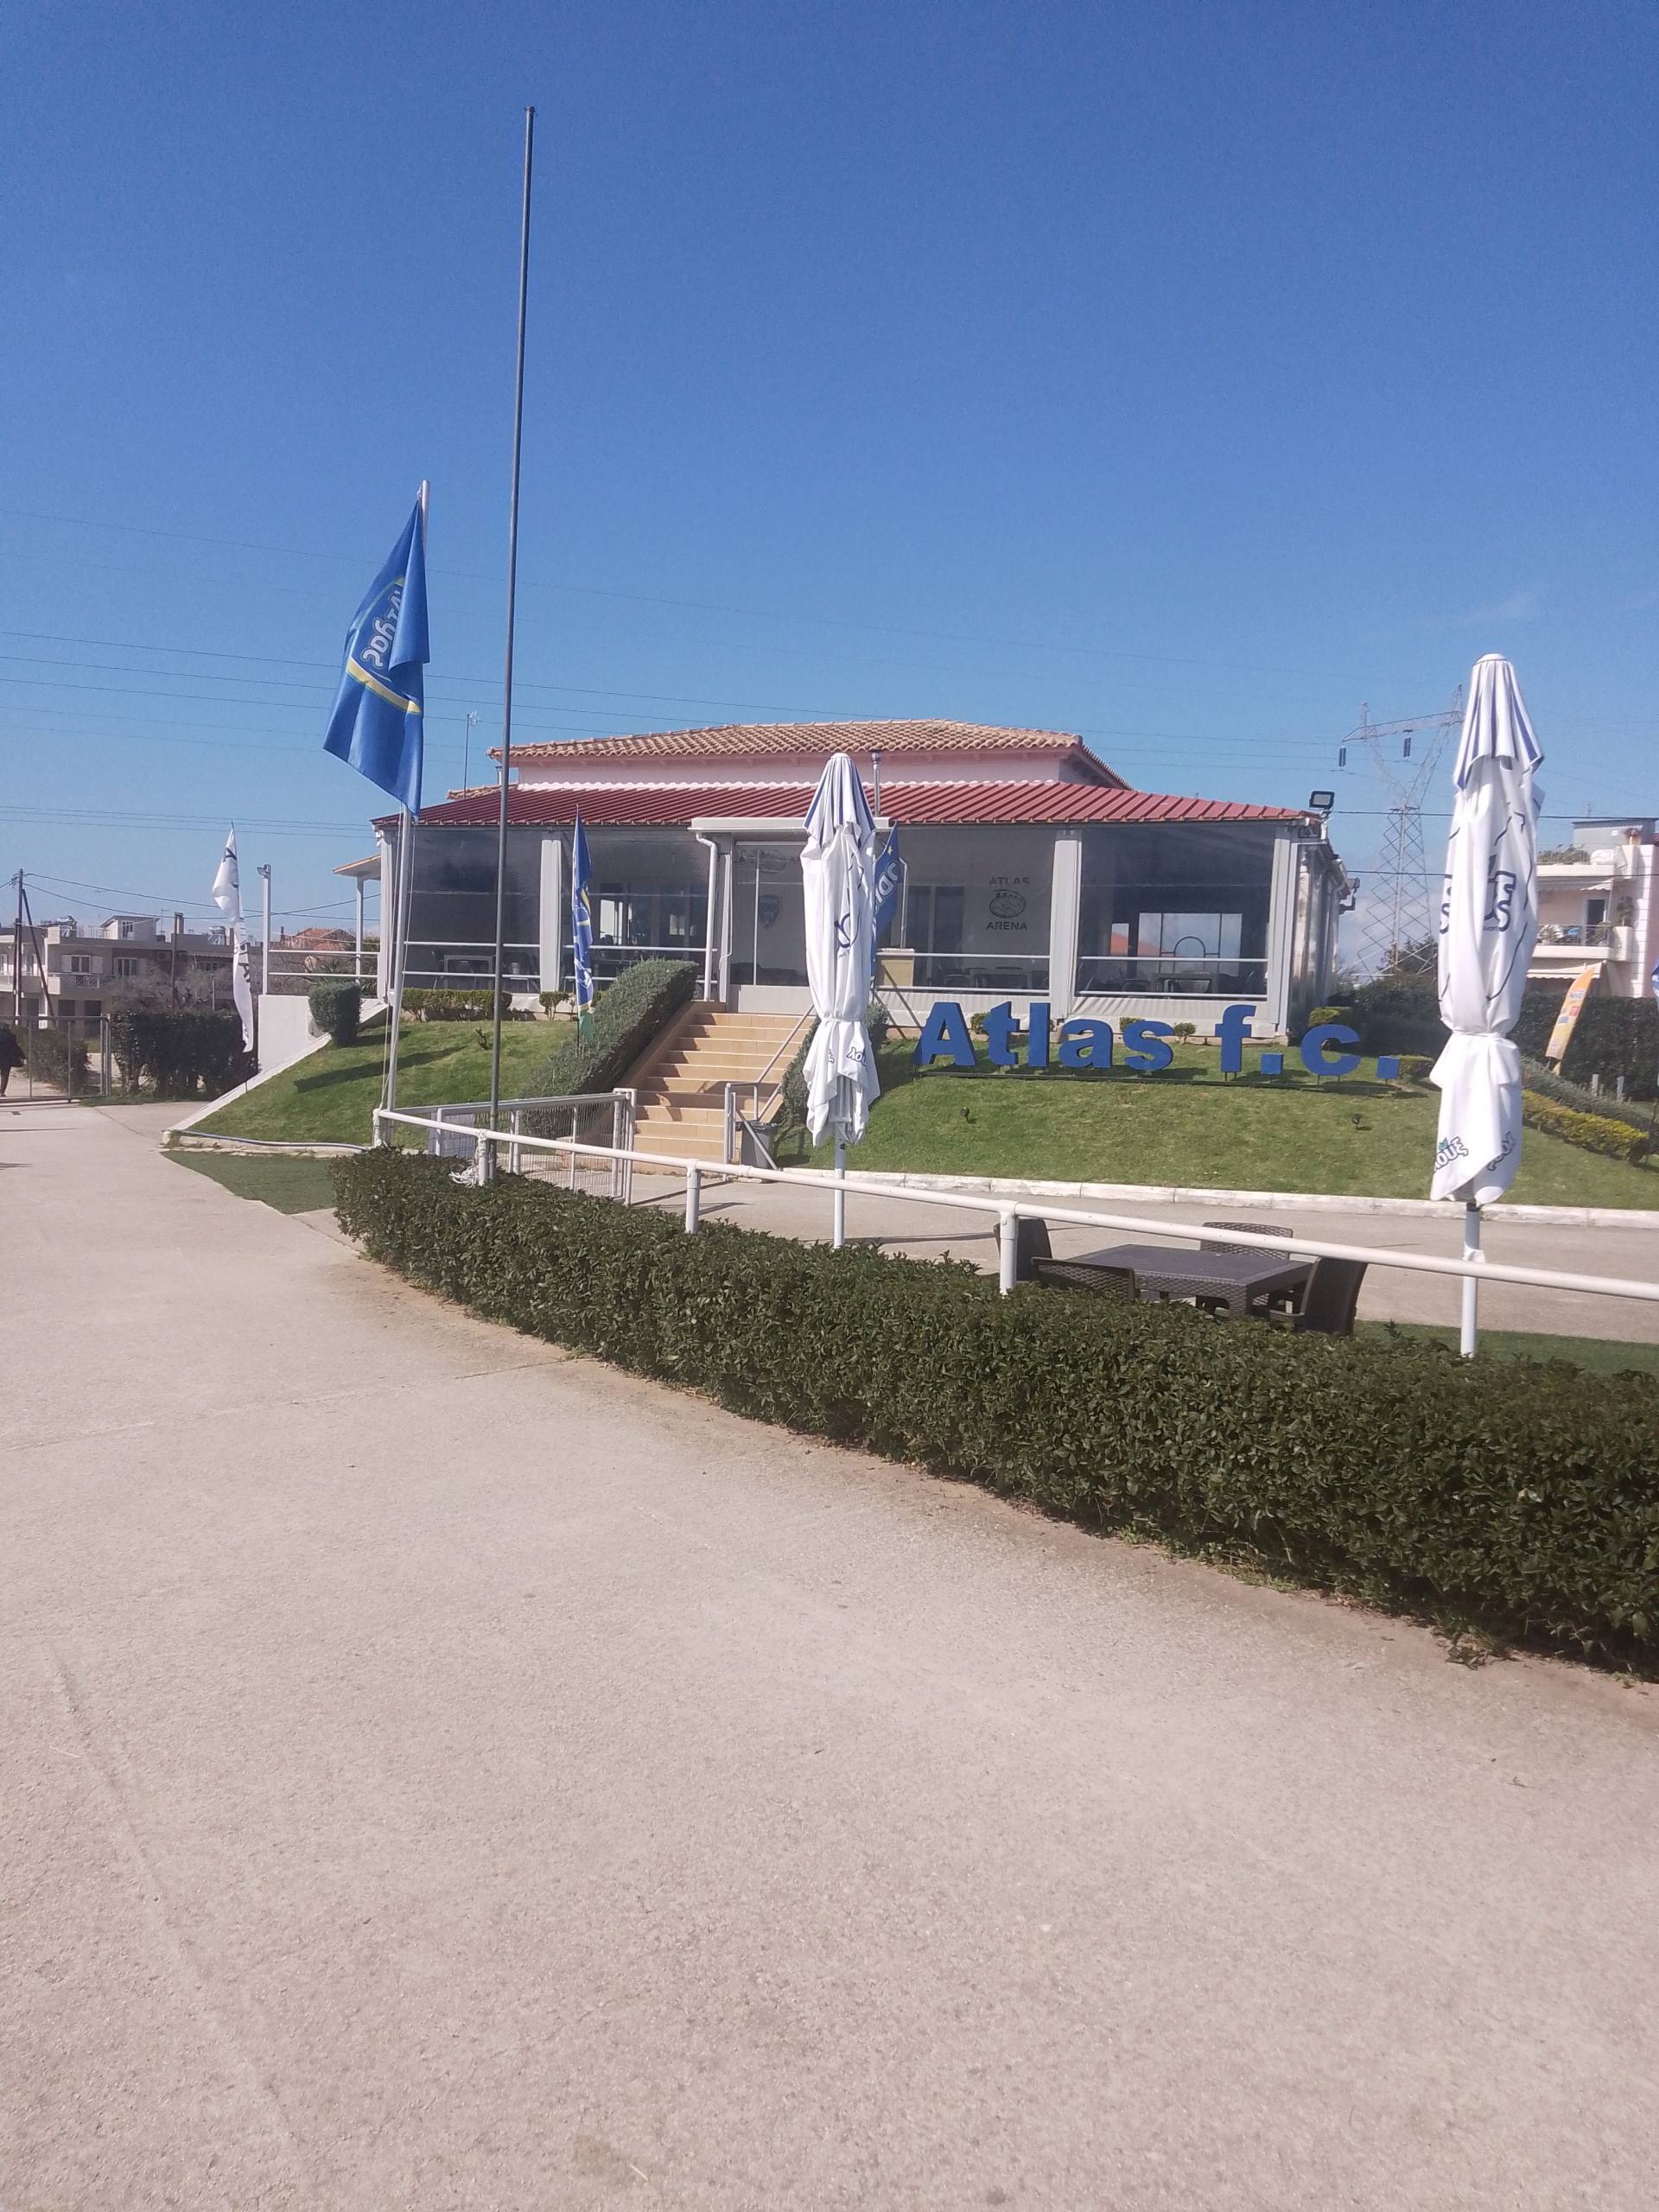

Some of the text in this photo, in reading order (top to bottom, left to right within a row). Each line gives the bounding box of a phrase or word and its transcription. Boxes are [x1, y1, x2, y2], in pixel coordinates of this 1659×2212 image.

[988, 876, 1030, 886] ATLAS
[987, 921, 1027, 931] ARENA
[920, 1001, 1175, 1071] Atlas
